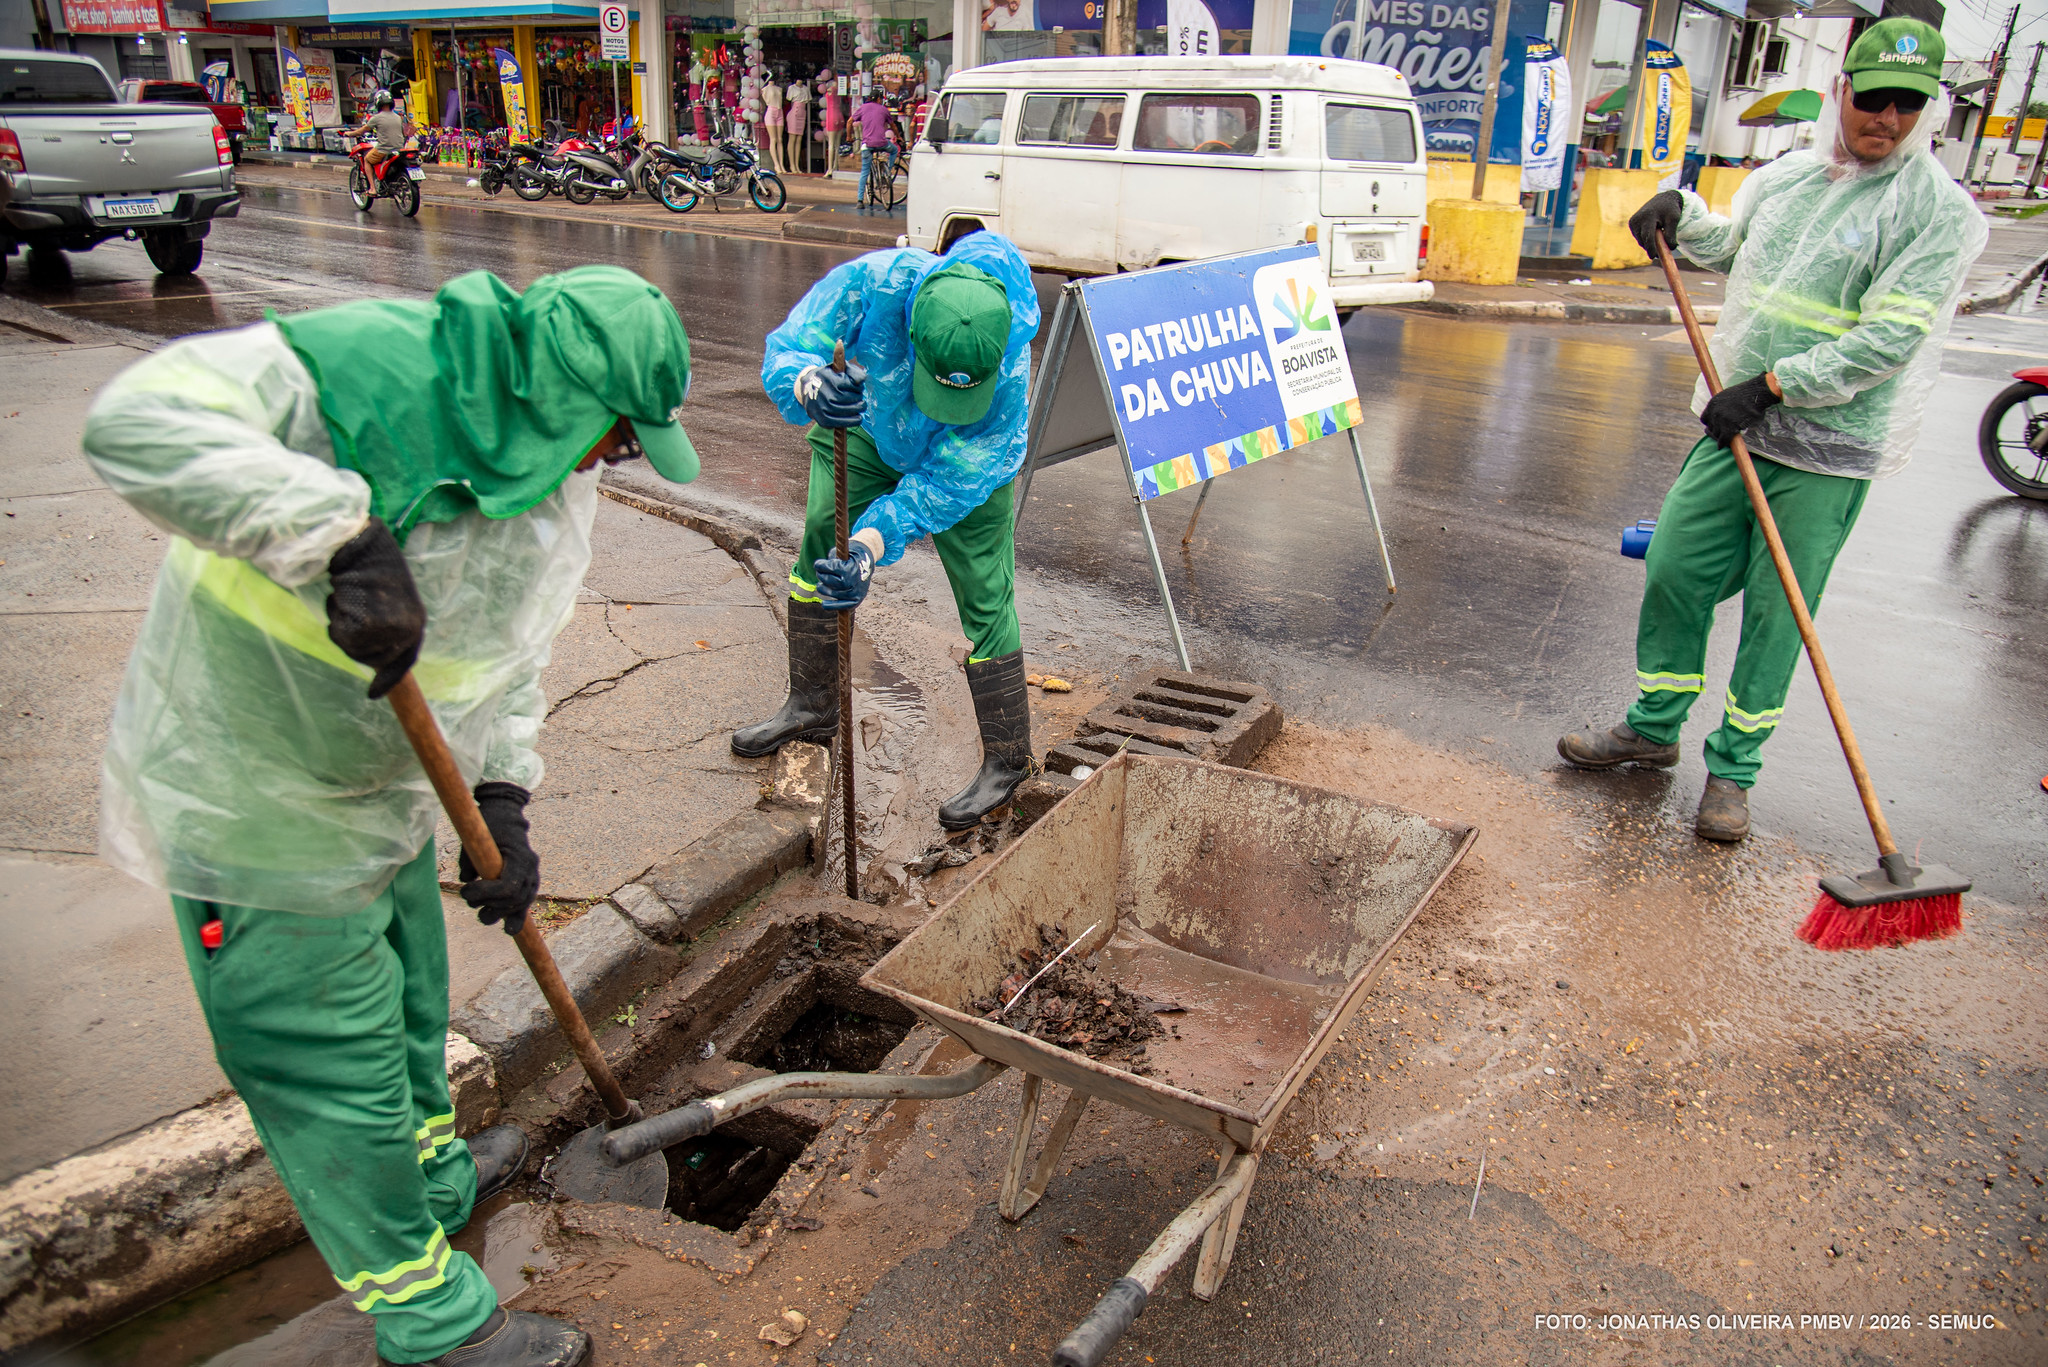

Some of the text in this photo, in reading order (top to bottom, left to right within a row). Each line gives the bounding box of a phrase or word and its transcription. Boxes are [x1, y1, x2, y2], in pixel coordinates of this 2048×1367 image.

[76, 7, 90, 25] Pet
[90, 6, 107, 29] shop
[111, 5, 135, 25] banho
[135, 9, 141, 24] e
[140, 5, 159, 25] tosa
[610, 12, 619, 27] E
[1430, 5, 1489, 31] DAS
[1527, 43, 1553, 54] MEGA
[1647, 50, 1675, 59] MEGA
[875, 52, 911, 66] SHOW DE
[1105, 304, 1261, 371] PATRULHA
[1290, 339, 1317, 350] PREFEITURA
[1120, 350, 1273, 423] DA CHUVA
[1287, 376, 1313, 388] SECRETARIA
[1313, 369, 1336, 380] MUNICIPAL
